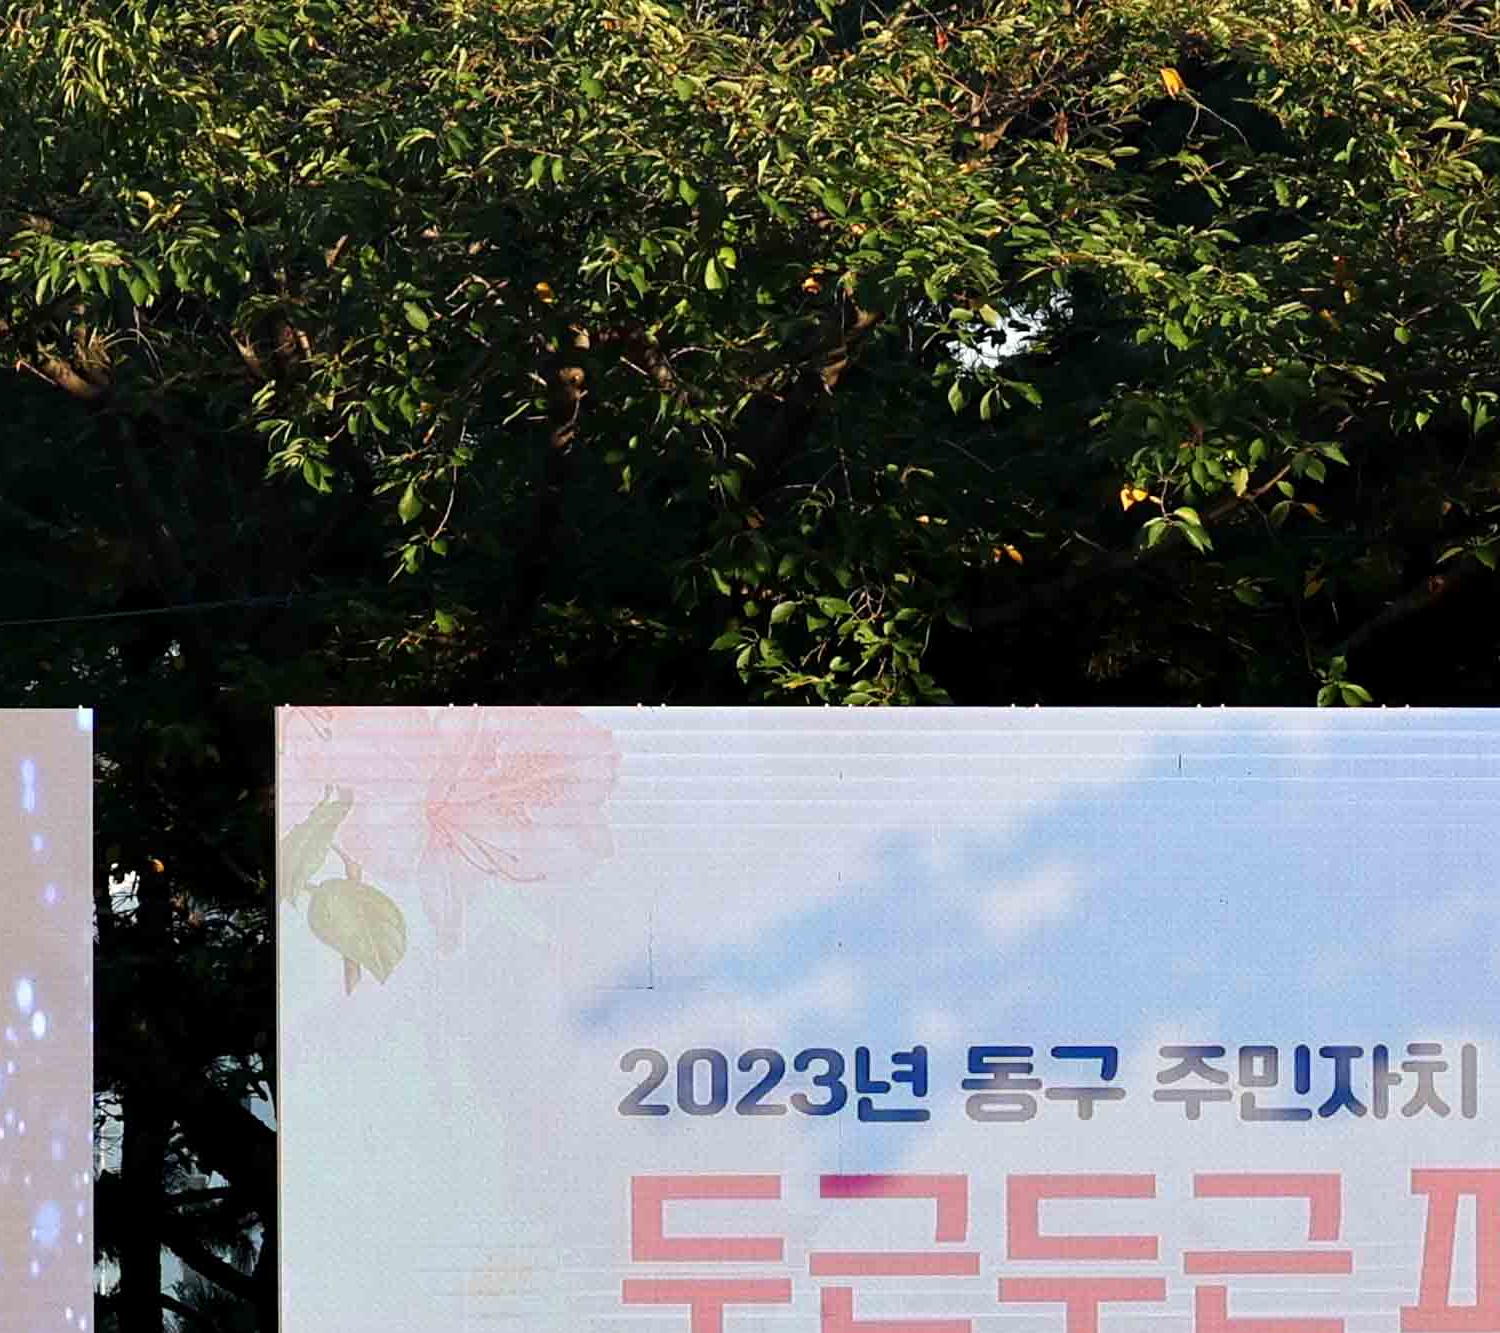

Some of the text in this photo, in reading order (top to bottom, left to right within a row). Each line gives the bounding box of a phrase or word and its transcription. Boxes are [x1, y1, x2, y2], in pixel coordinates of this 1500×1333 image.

[616, 1044, 1480, 1123] 2023년 동구 주민자치
